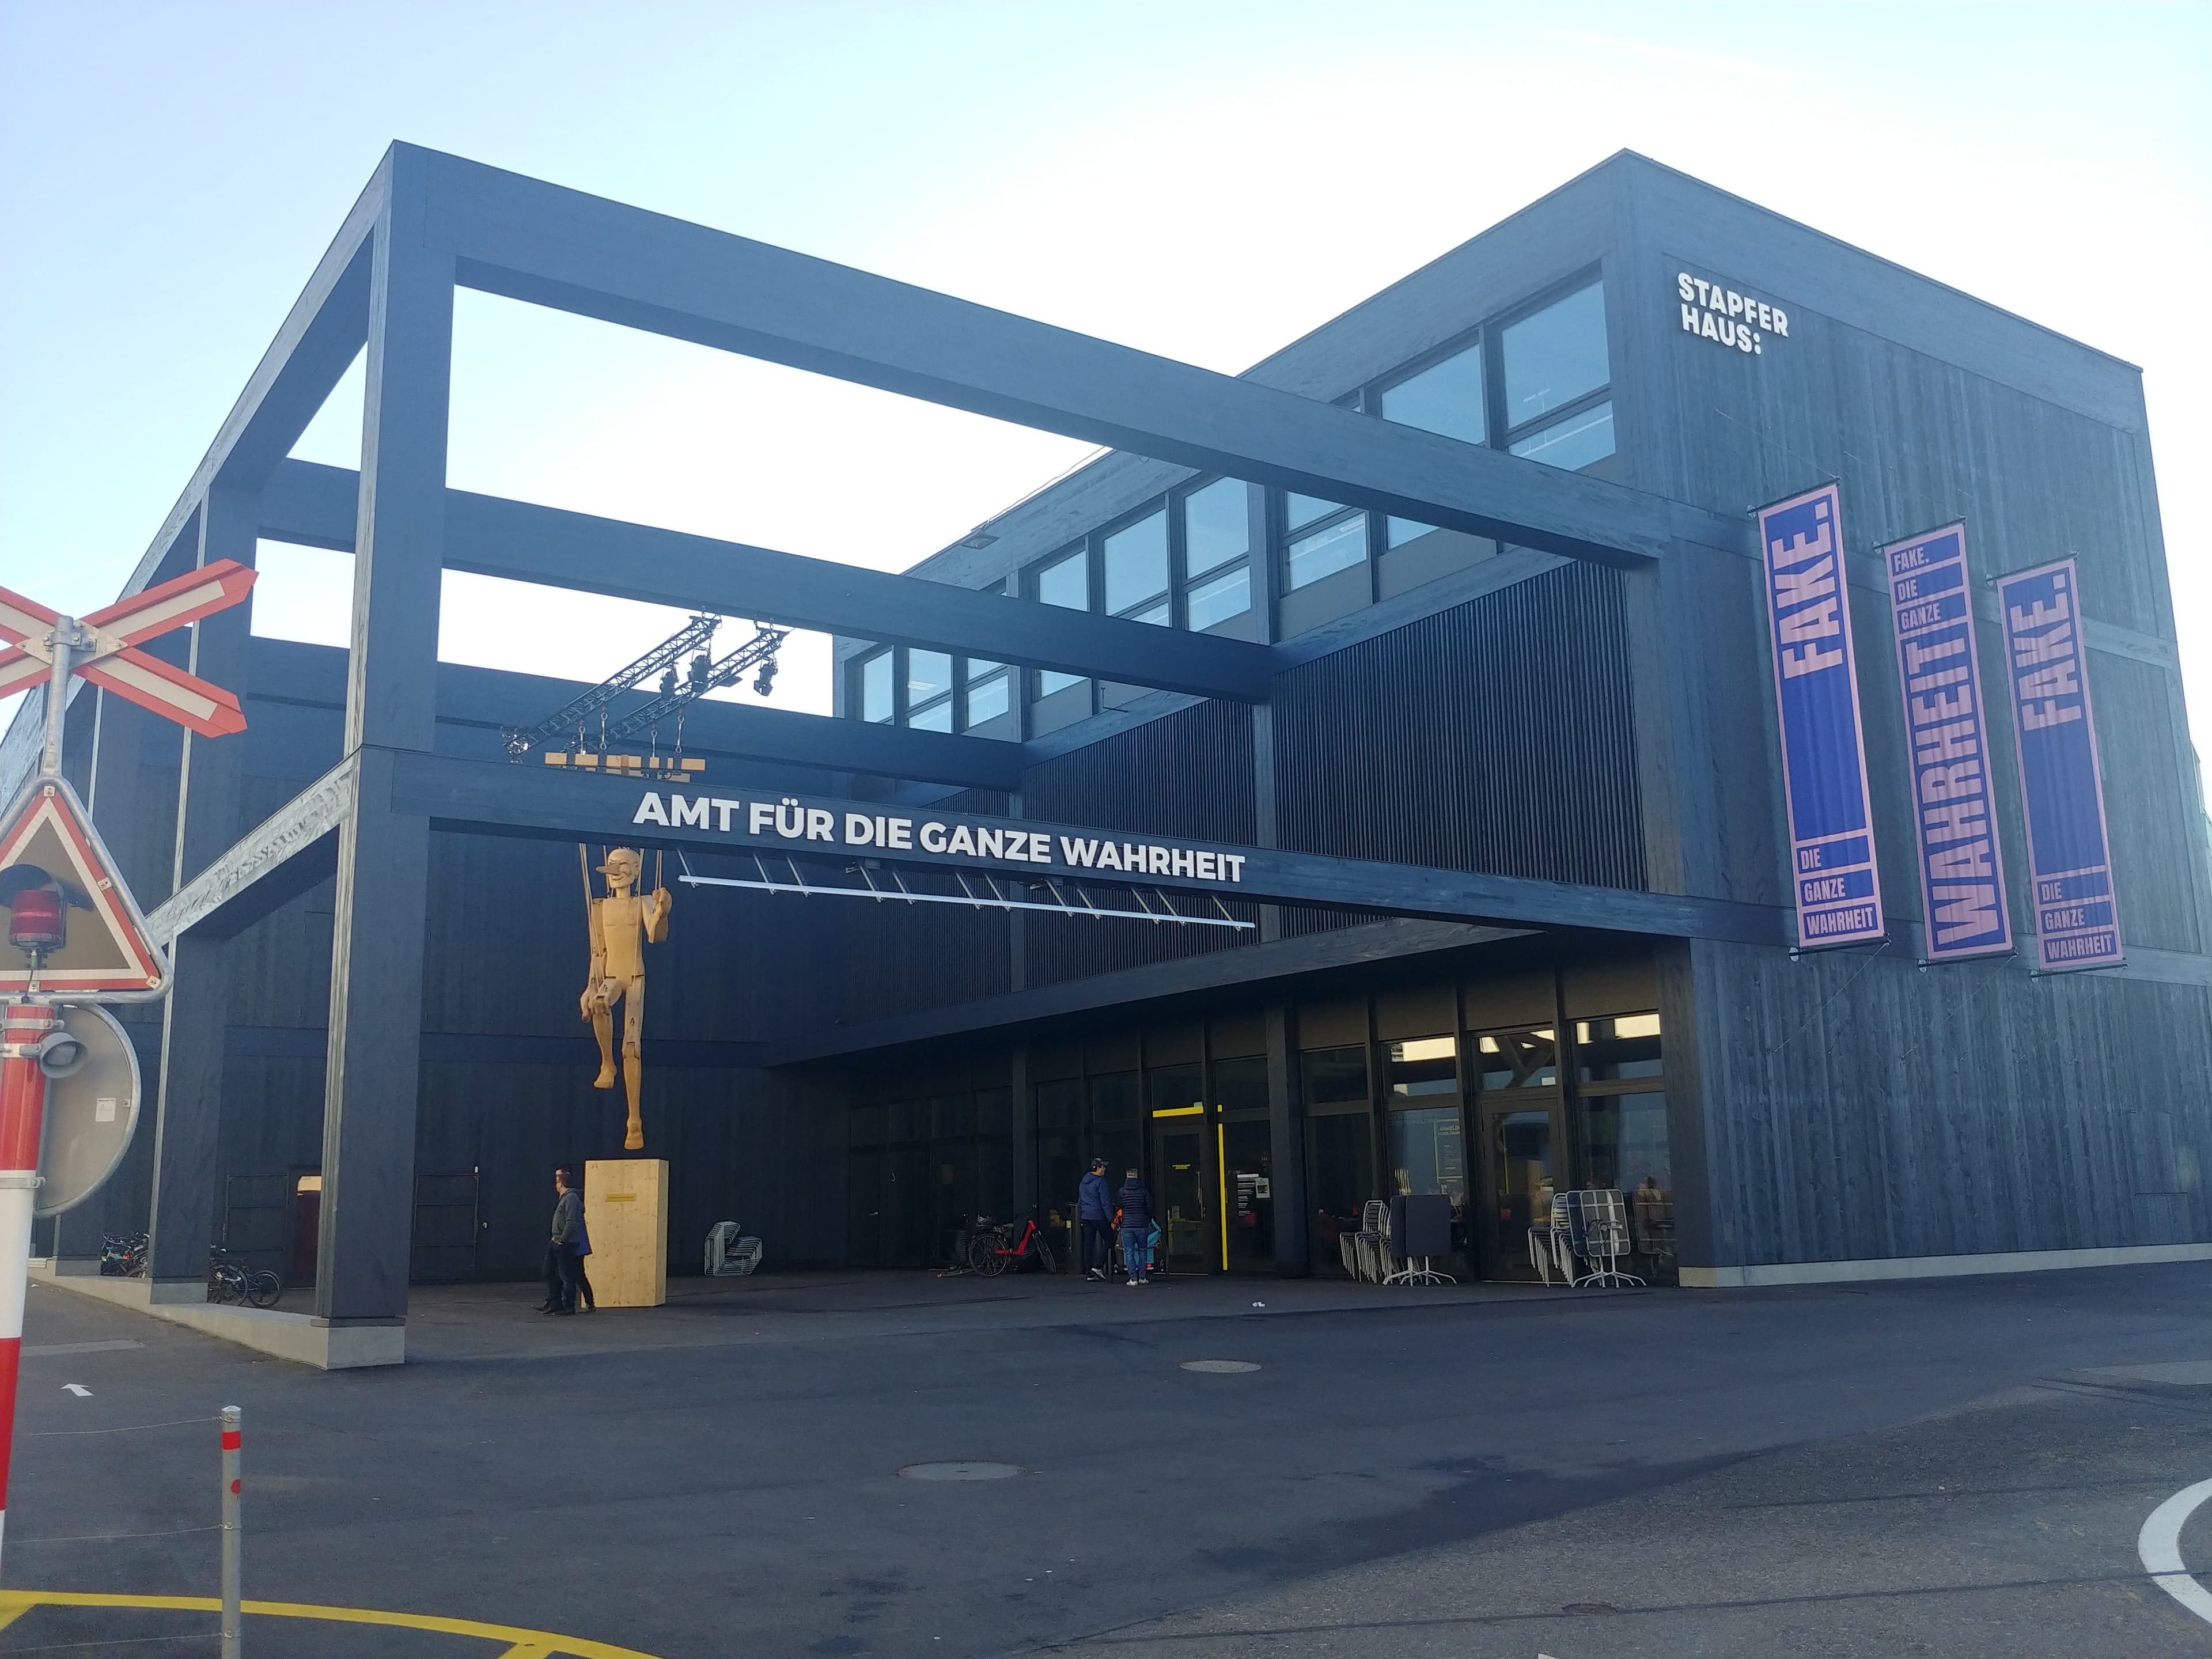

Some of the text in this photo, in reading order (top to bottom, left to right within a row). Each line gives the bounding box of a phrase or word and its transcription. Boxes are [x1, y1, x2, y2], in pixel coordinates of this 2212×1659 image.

[1677, 272, 1789, 338] STAPFER
[1681, 303, 1762, 355] HAUS:
[1893, 547, 1929, 573] FAKE.
[1771, 501, 1844, 680] FAKE.
[1897, 579, 1918, 601] DIE
[1901, 603, 1941, 630] GANZE
[2010, 574, 2082, 732] FAKE.
[1905, 637, 1999, 946] WAHRHEIT
[632, 791, 1246, 882] AMT FÜR DIE GANZE WAHRHEIT
[1800, 848, 1821, 870] DIE
[1804, 877, 1846, 903] GANZE
[2041, 882, 2062, 902] DIE
[1806, 907, 1873, 935] WAHRHEIT
[2045, 908, 2085, 931] GANZE
[2047, 934, 2112, 960] WAHRHEIT
